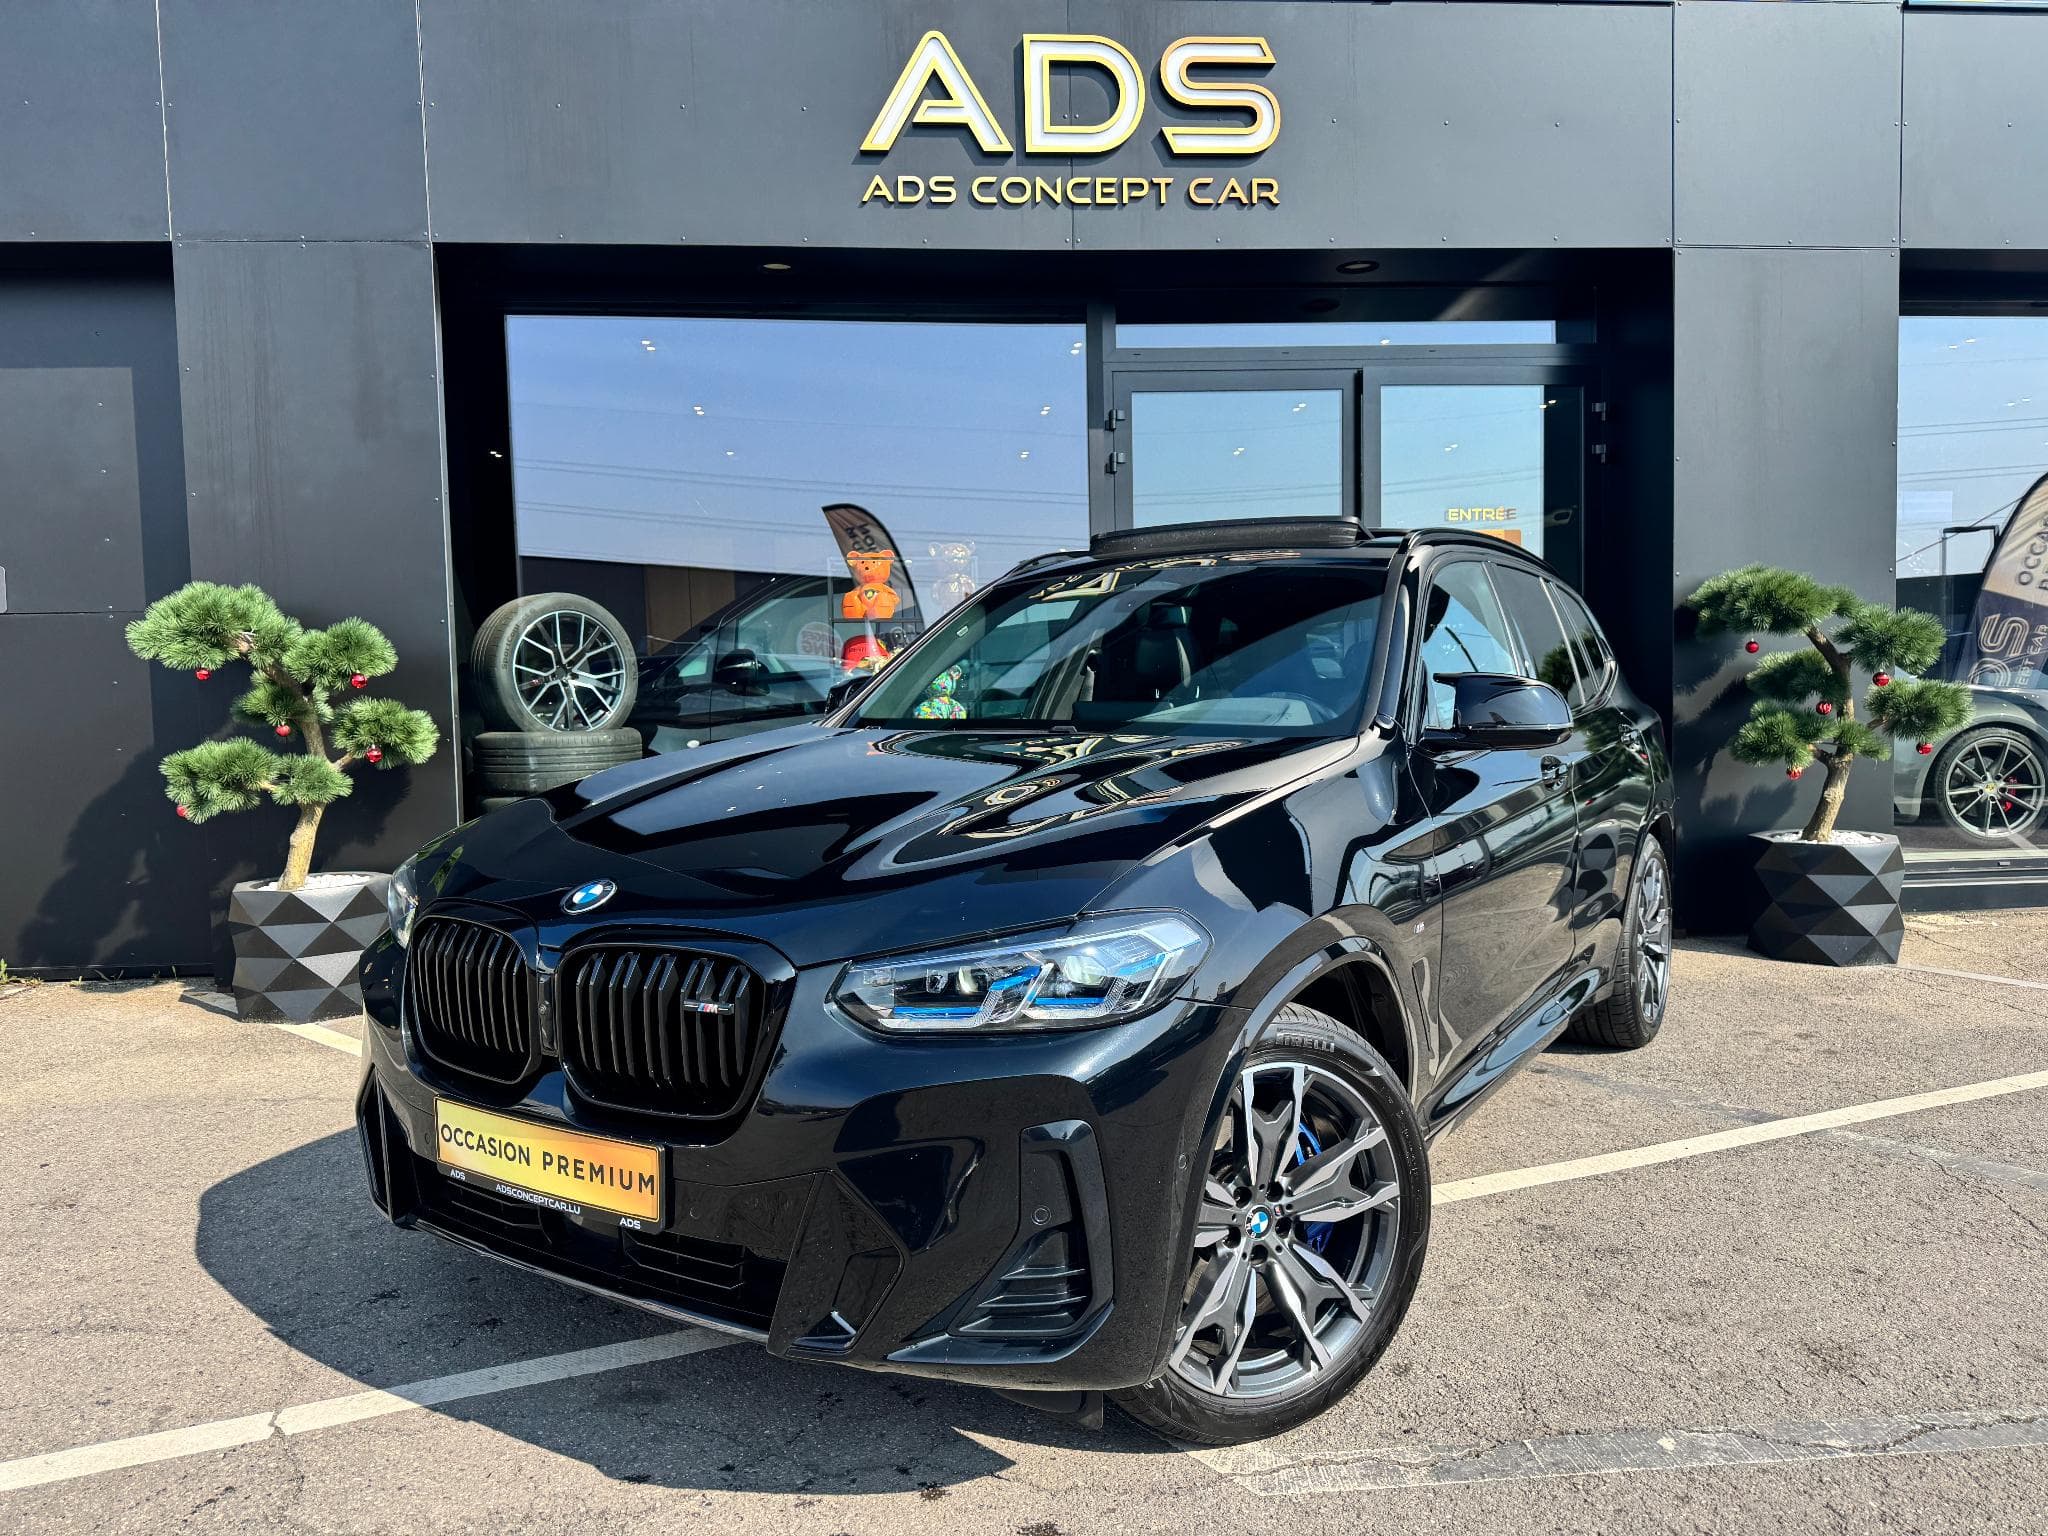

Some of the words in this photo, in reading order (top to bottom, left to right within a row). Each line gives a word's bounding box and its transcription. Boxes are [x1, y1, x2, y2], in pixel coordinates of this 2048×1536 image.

[860, 30, 1281, 154] ADS
[862, 174, 956, 203] ADS
[971, 176, 1175, 204] CONCEPT
[1188, 177, 1281, 204] CAR
[440, 1123, 532, 1167] OCCASION
[542, 1150, 655, 1196] PREMIUM
[450, 1168, 466, 1181] ADS
[495, 1183, 582, 1215] ADSCONCEPTCAR.LU
[619, 1217, 642, 1230] ADS
